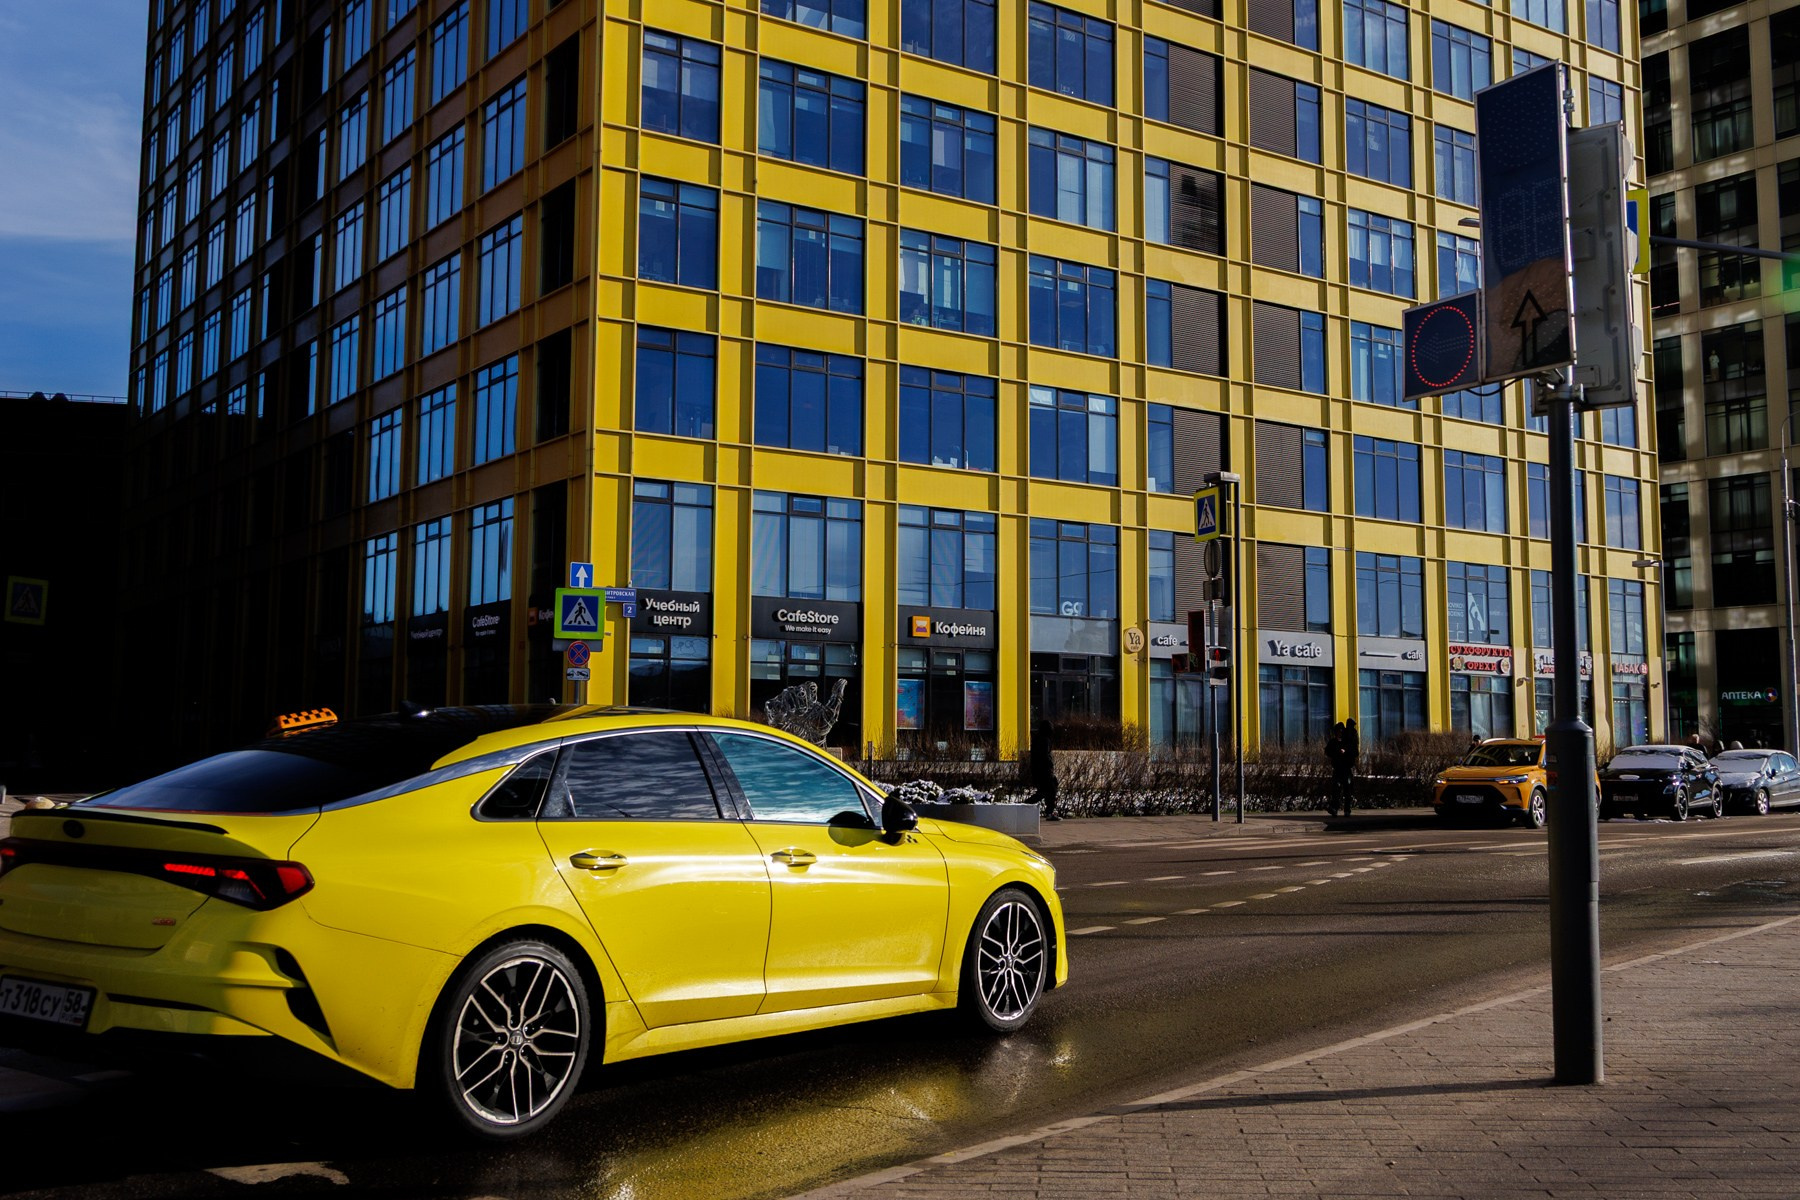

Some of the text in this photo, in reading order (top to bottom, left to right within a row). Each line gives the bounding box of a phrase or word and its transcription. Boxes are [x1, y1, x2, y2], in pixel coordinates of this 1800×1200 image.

[627, 606, 632, 614] 2
[645, 598, 700, 613] Учебный
[653, 615, 692, 629] центр
[777, 608, 839, 624] CafeStore
[785, 624, 795, 632] We
[817, 627, 832, 635] easy
[935, 621, 986, 637] Кофейня
[1128, 632, 1141, 645] Ya
[1158, 634, 1178, 646] cafe
[1275, 639, 1323, 658] Ya cafe
[1450, 646, 1512, 657] СУХОФРУКТЫ
[1406, 650, 1423, 660] cafe
[1721, 691, 1762, 700] АПТЕКА
